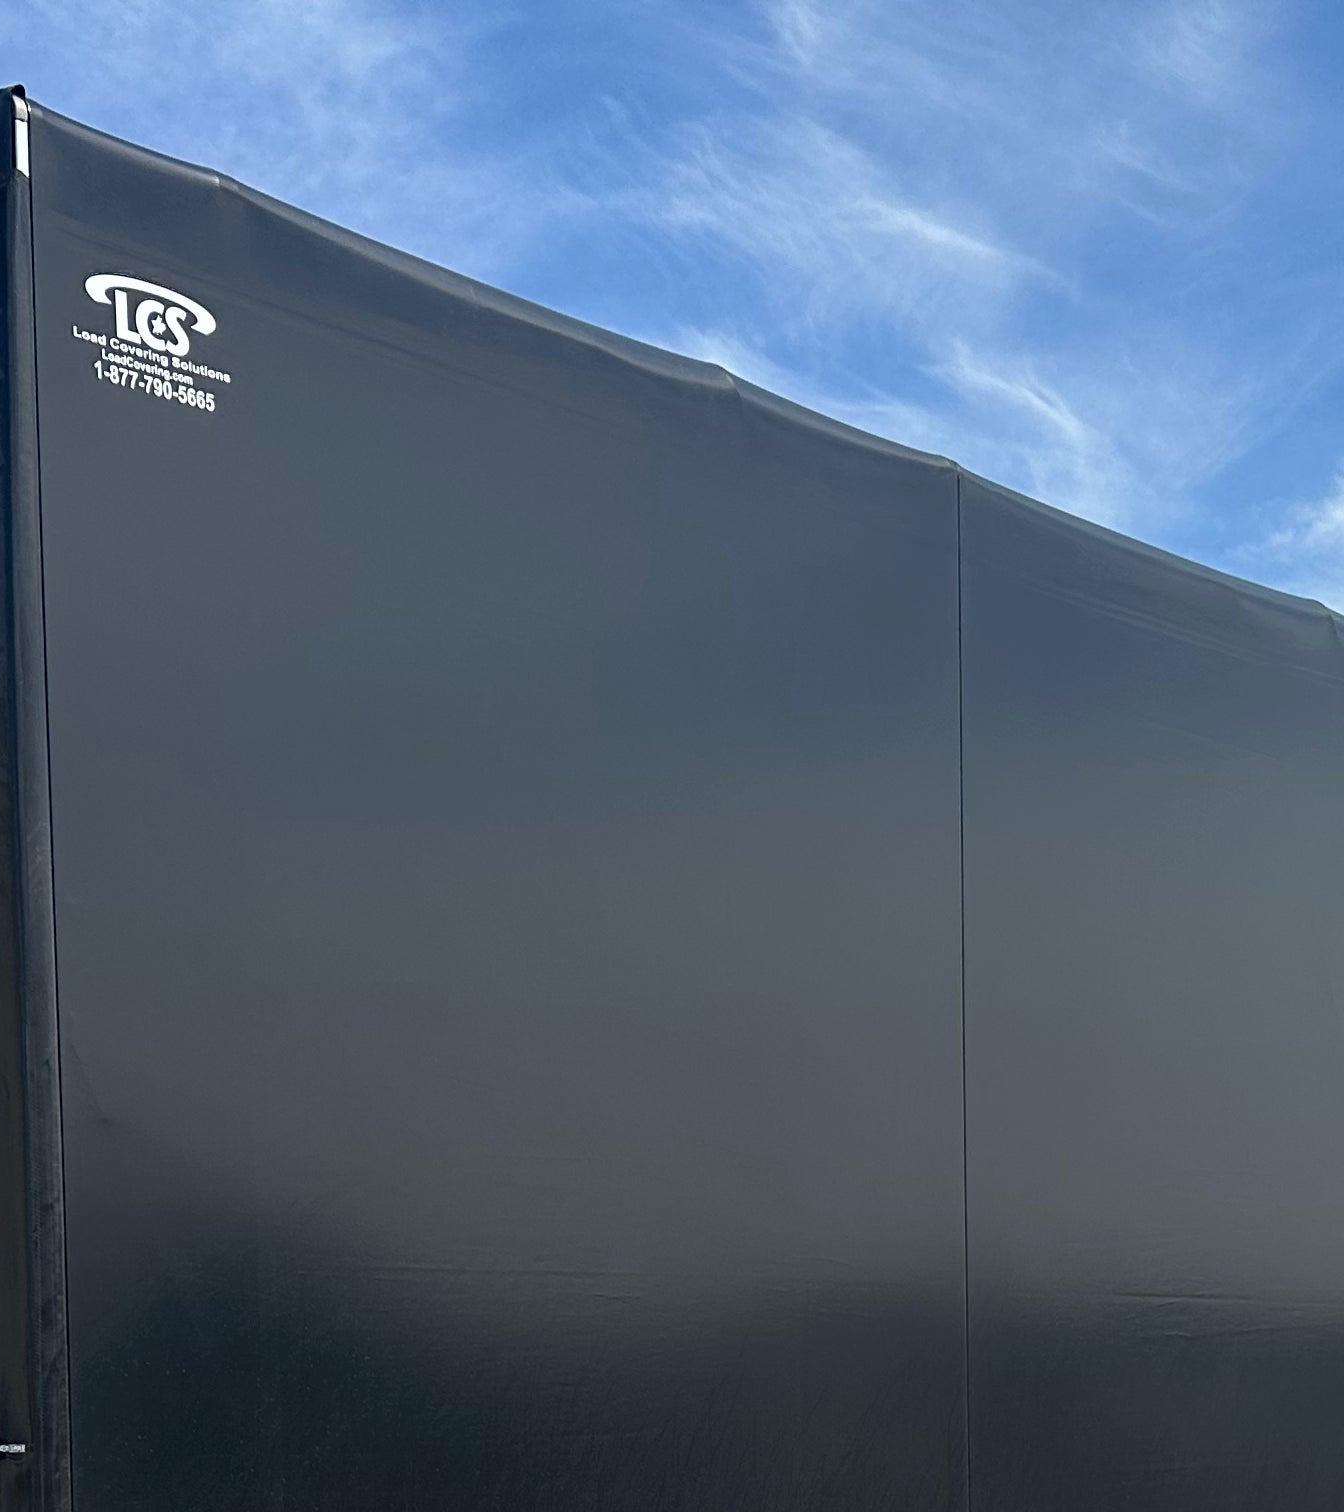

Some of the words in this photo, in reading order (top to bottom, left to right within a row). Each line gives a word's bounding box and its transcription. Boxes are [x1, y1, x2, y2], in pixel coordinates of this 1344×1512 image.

[114, 289, 190, 357] LCS
[72, 325, 107, 347] Load
[109, 337, 170, 367] Covering
[171, 356, 231, 384] Solutions
[101, 348, 194, 386] LoadCovering.com
[94, 360, 216, 412] 1-877-790-5665
